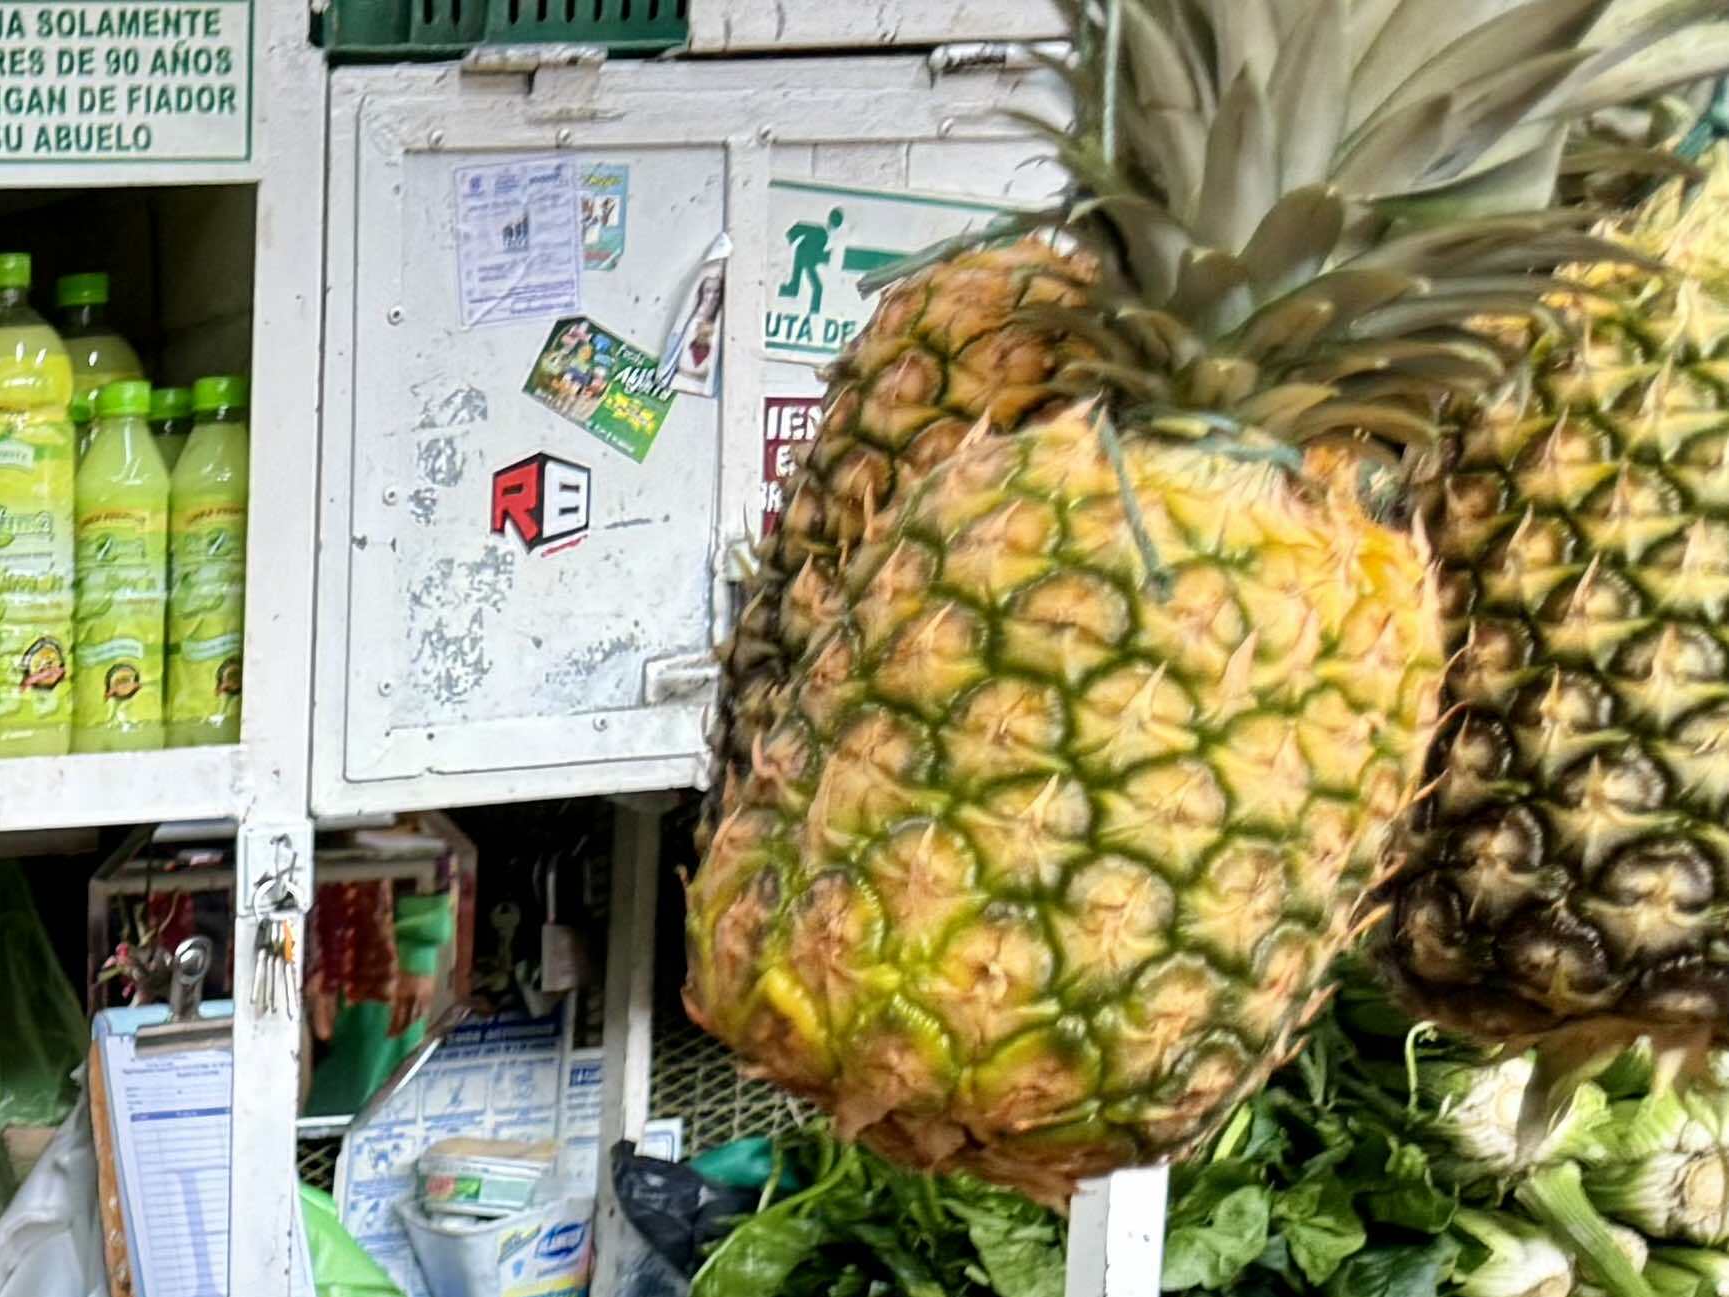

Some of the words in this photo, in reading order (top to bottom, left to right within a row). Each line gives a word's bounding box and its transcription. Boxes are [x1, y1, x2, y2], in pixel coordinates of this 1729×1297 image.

[36, 8, 222, 38] SOLAMENTE
[56, 48, 96, 77] DE
[105, 47, 140, 76] 90
[150, 40, 233, 76] AÑOS
[78, 86, 117, 115] DE
[126, 86, 238, 114] FIADOR
[33, 122, 152, 152] ABUELO
[765, 312, 813, 342] UTA
